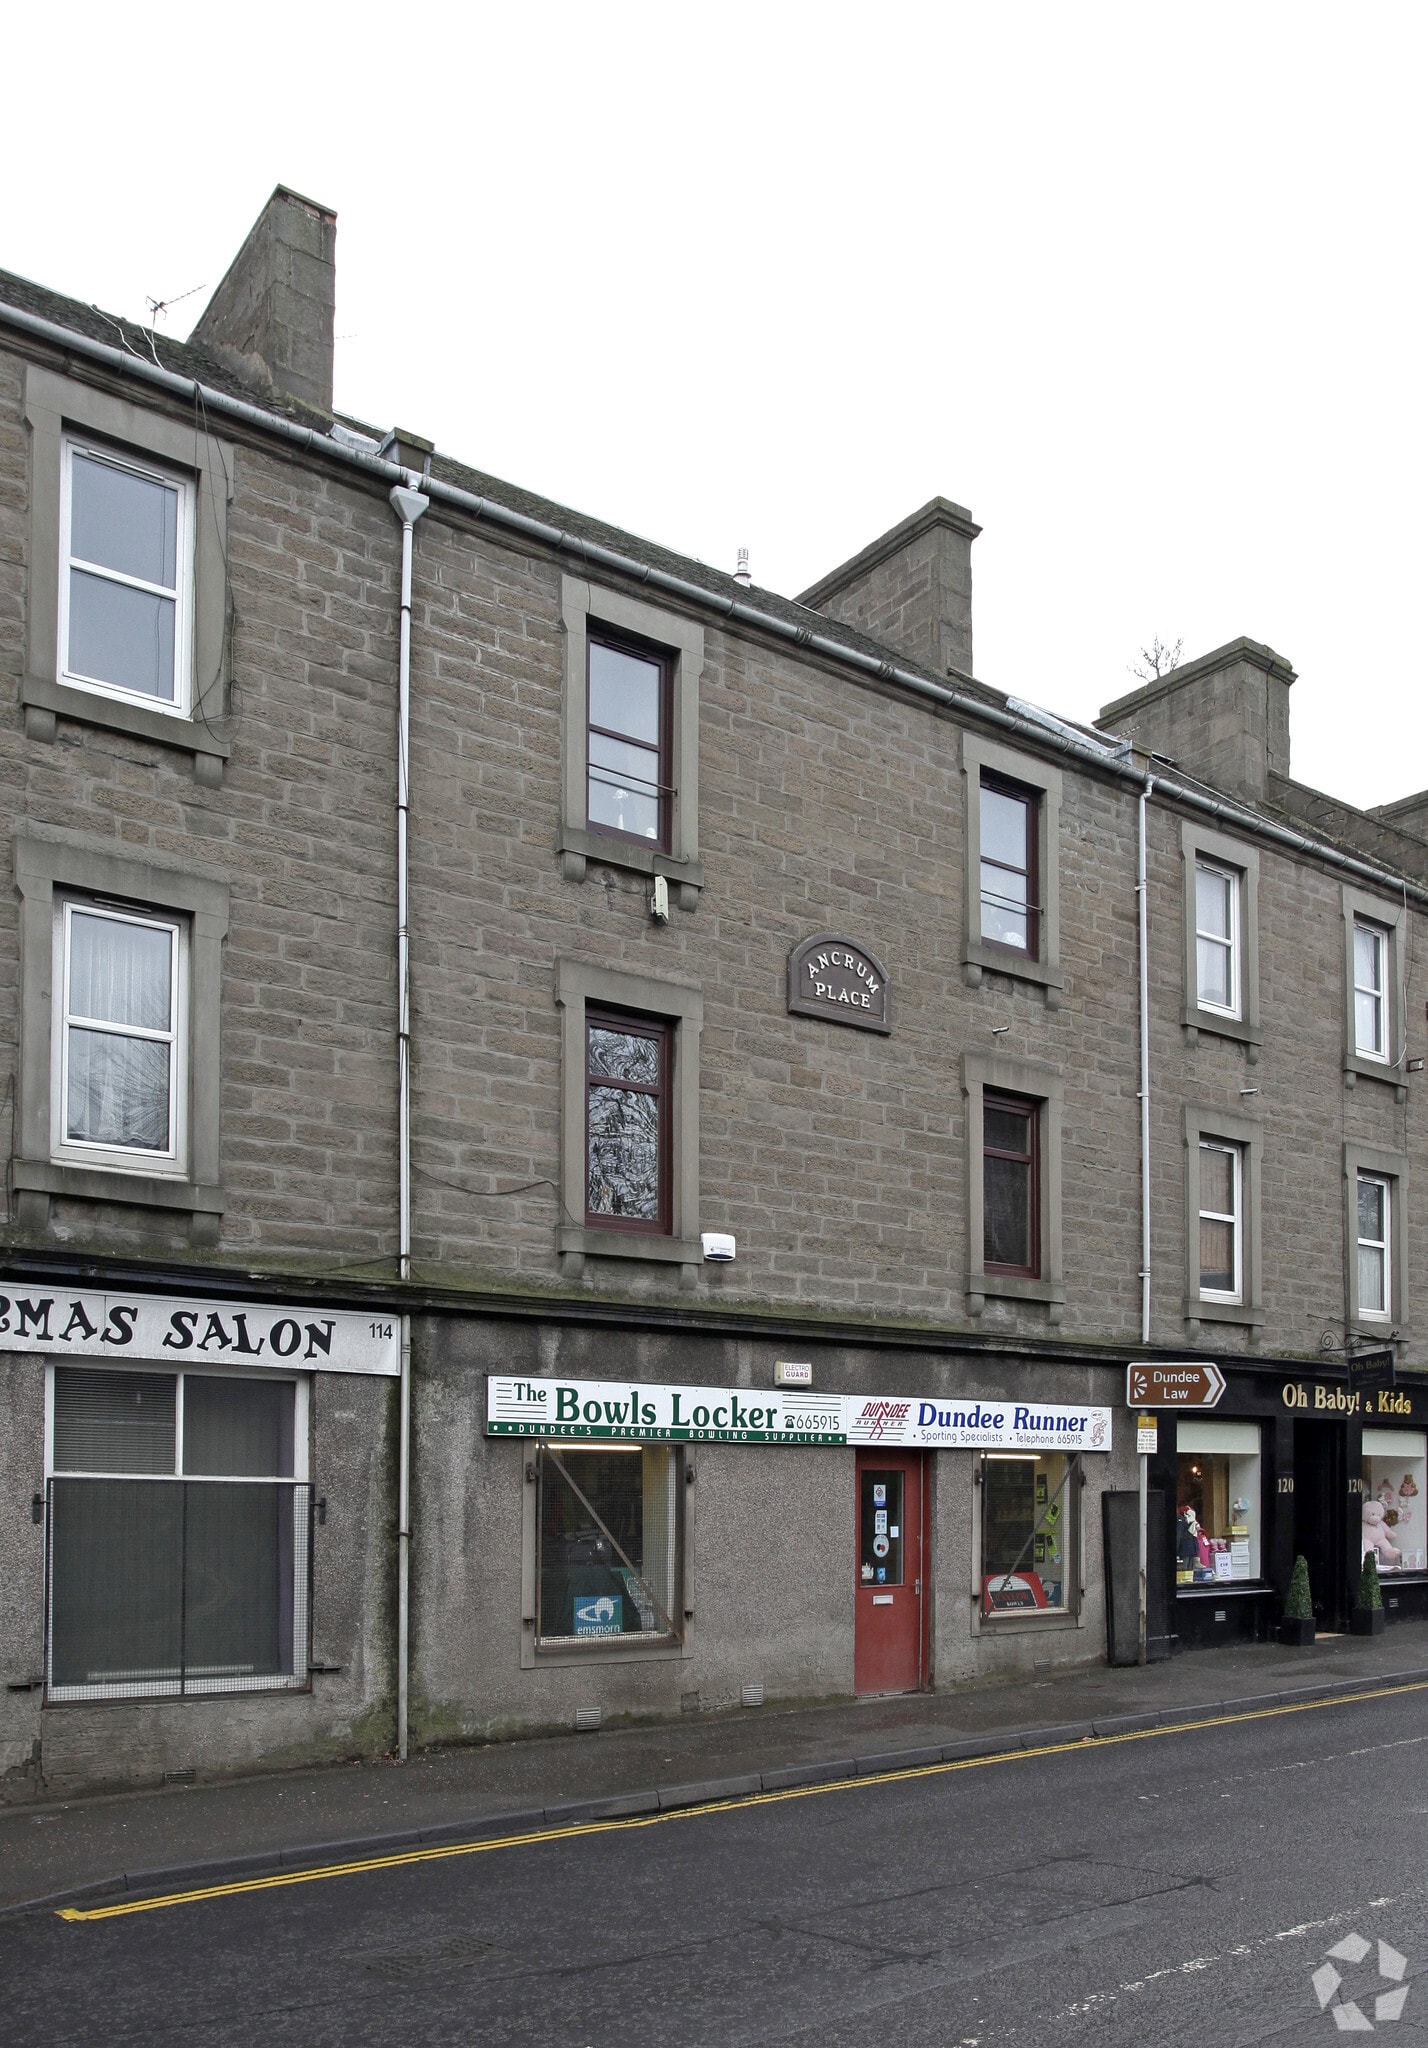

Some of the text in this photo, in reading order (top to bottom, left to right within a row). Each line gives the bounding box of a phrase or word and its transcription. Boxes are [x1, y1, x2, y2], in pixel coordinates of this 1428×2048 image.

[807, 951, 880, 995] ANCRUM
[814, 981, 871, 1008] PLACE
[162, 1310, 337, 1361] SALON
[368, 1322, 393, 1340] 114
[785, 1364, 810, 1372] ELECTRO
[1153, 1371, 1200, 1383] Dundee
[1163, 1388, 1189, 1400] Law
[1282, 1383, 1412, 1416] Oh Baby! & Kids
[513, 1382, 778, 1429] The Bowls Locker
[861, 1401, 912, 1418] DUNDEE
[796, 1414, 840, 1430] 665915
[917, 1403, 1088, 1432] Dundee Runner
[518, 1424, 823, 1442] DUNDEE'S PREMIER BOWLING SUPPLIER
[920, 1429, 1083, 1445] Sporting Specialists Telephone 665915
[1277, 1478, 1294, 1493] 120
[1348, 1478, 1363, 1493] 120
